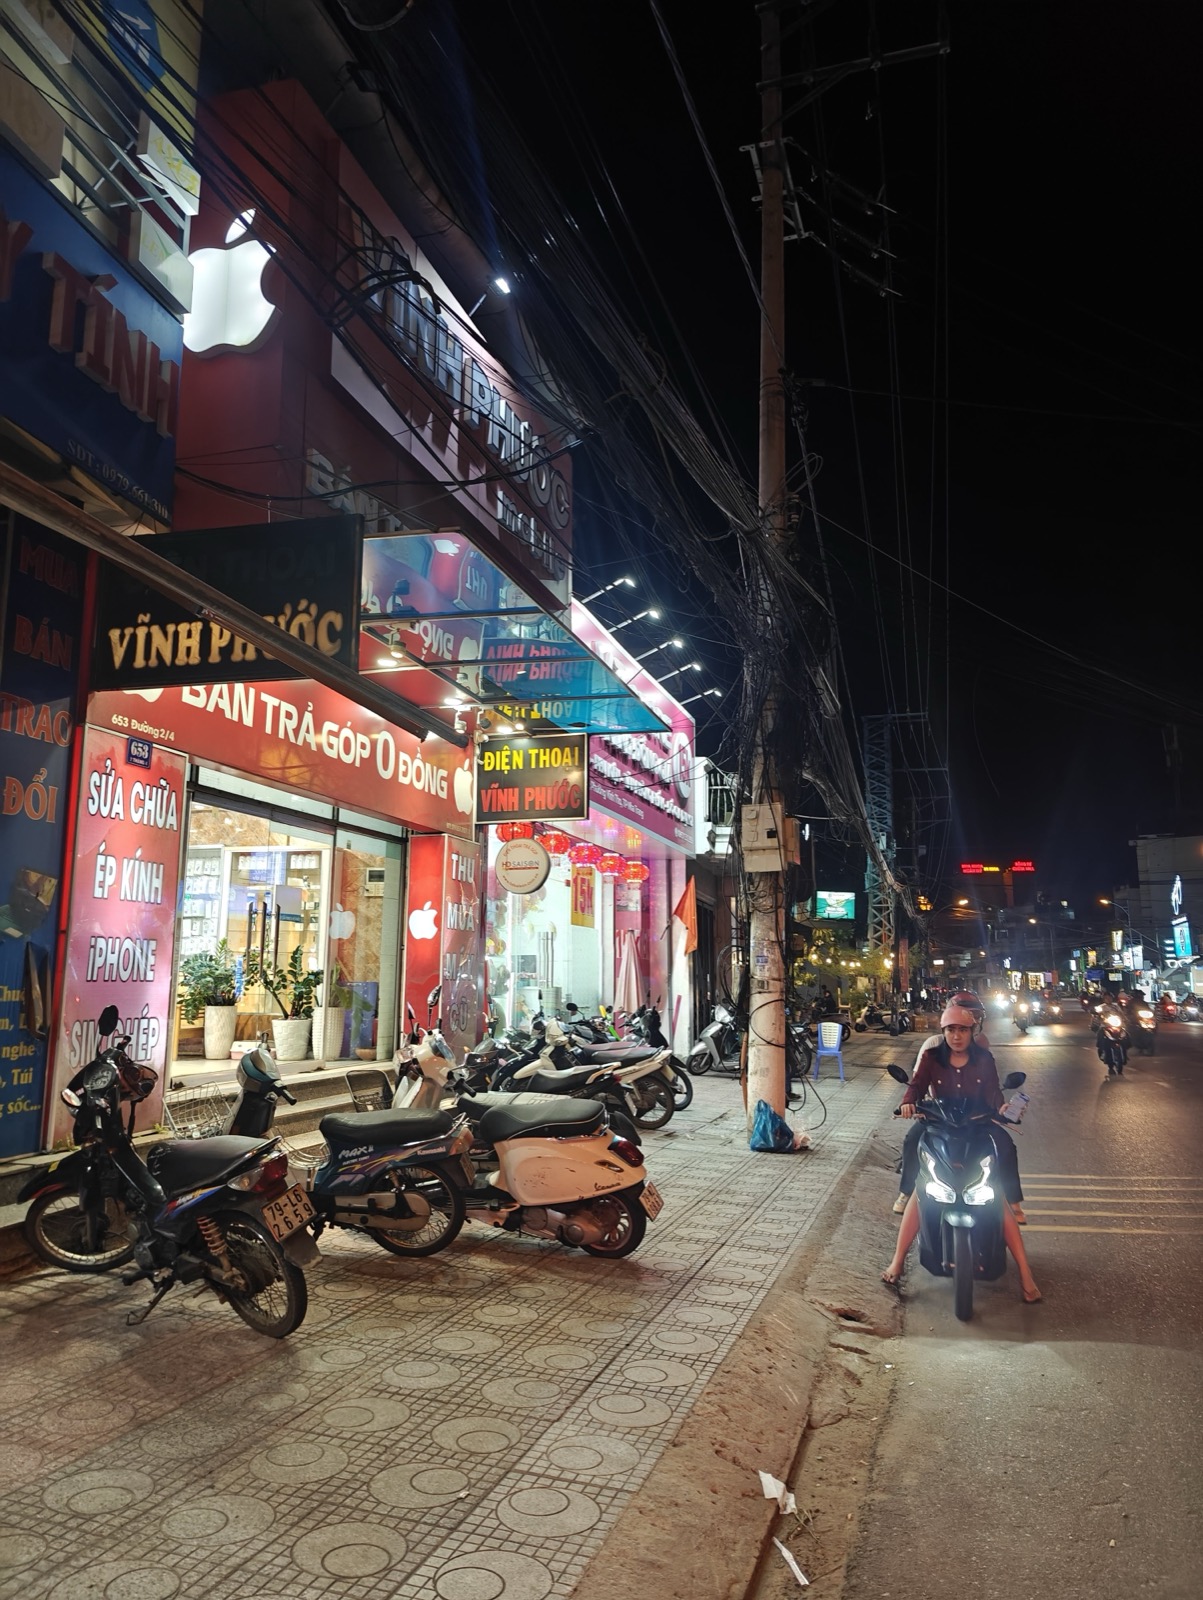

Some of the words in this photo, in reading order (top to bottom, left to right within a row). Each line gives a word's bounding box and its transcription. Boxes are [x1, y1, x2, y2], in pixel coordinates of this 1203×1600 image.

[42, 250, 180, 439] TÍNH
[19, 535, 81, 600] MUA
[13, 613, 72, 671] BÁN
[107, 612, 203, 670] VĨNH
[0, 690, 71, 747] TRAO
[111, 713, 129, 728] 653
[131, 741, 149, 759] 653
[260, 701, 318, 751] TRẢ
[322, 721, 371, 768] GÓP
[398, 746, 448, 800] ĐỒNG
[483, 745, 524, 774] ĐIỆN
[528, 746, 579, 771] THOẠI
[2, 767, 57, 823] ĐỔI
[87, 757, 125, 820] SỬA
[129, 776, 178, 830] CHỮA
[480, 782, 519, 812] VĨNH
[524, 778, 580, 810] PHƯỚC
[93, 840, 118, 899] ÉP
[119, 846, 164, 905] KÍNH
[451, 852, 475, 884] THU
[447, 902, 475, 932] MUA
[86, 936, 158, 982] iPHONE
[1, 1041, 36, 1060] nghe
[11, 1067, 33, 1086] Túi
[338, 1146, 368, 1159] MAX
[266, 1188, 304, 1221] 79-L6
[272, 1202, 313, 1239] 2659
